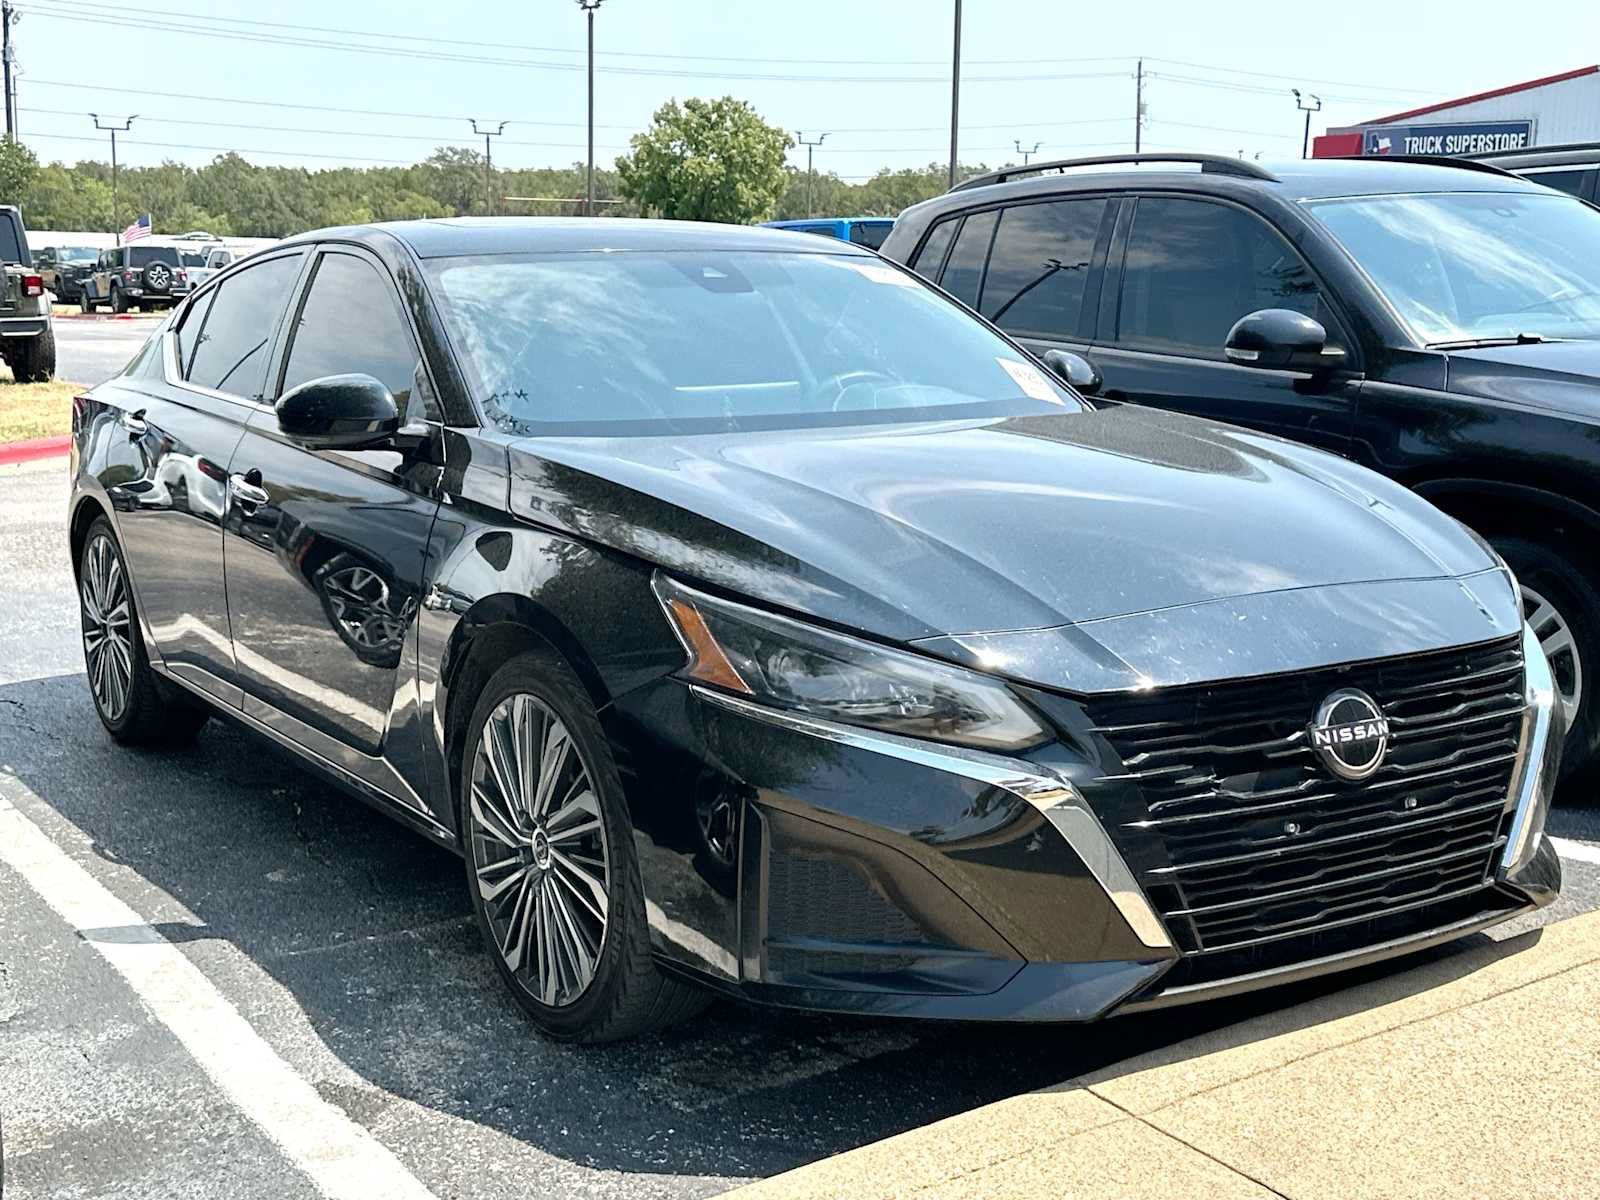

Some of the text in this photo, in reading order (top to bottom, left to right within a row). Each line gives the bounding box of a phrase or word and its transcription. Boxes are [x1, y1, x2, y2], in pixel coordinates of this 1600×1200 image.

[1404, 133, 1526, 154] TRUCK SUPERSTORE
[1314, 720, 1389, 744] NISSAN
